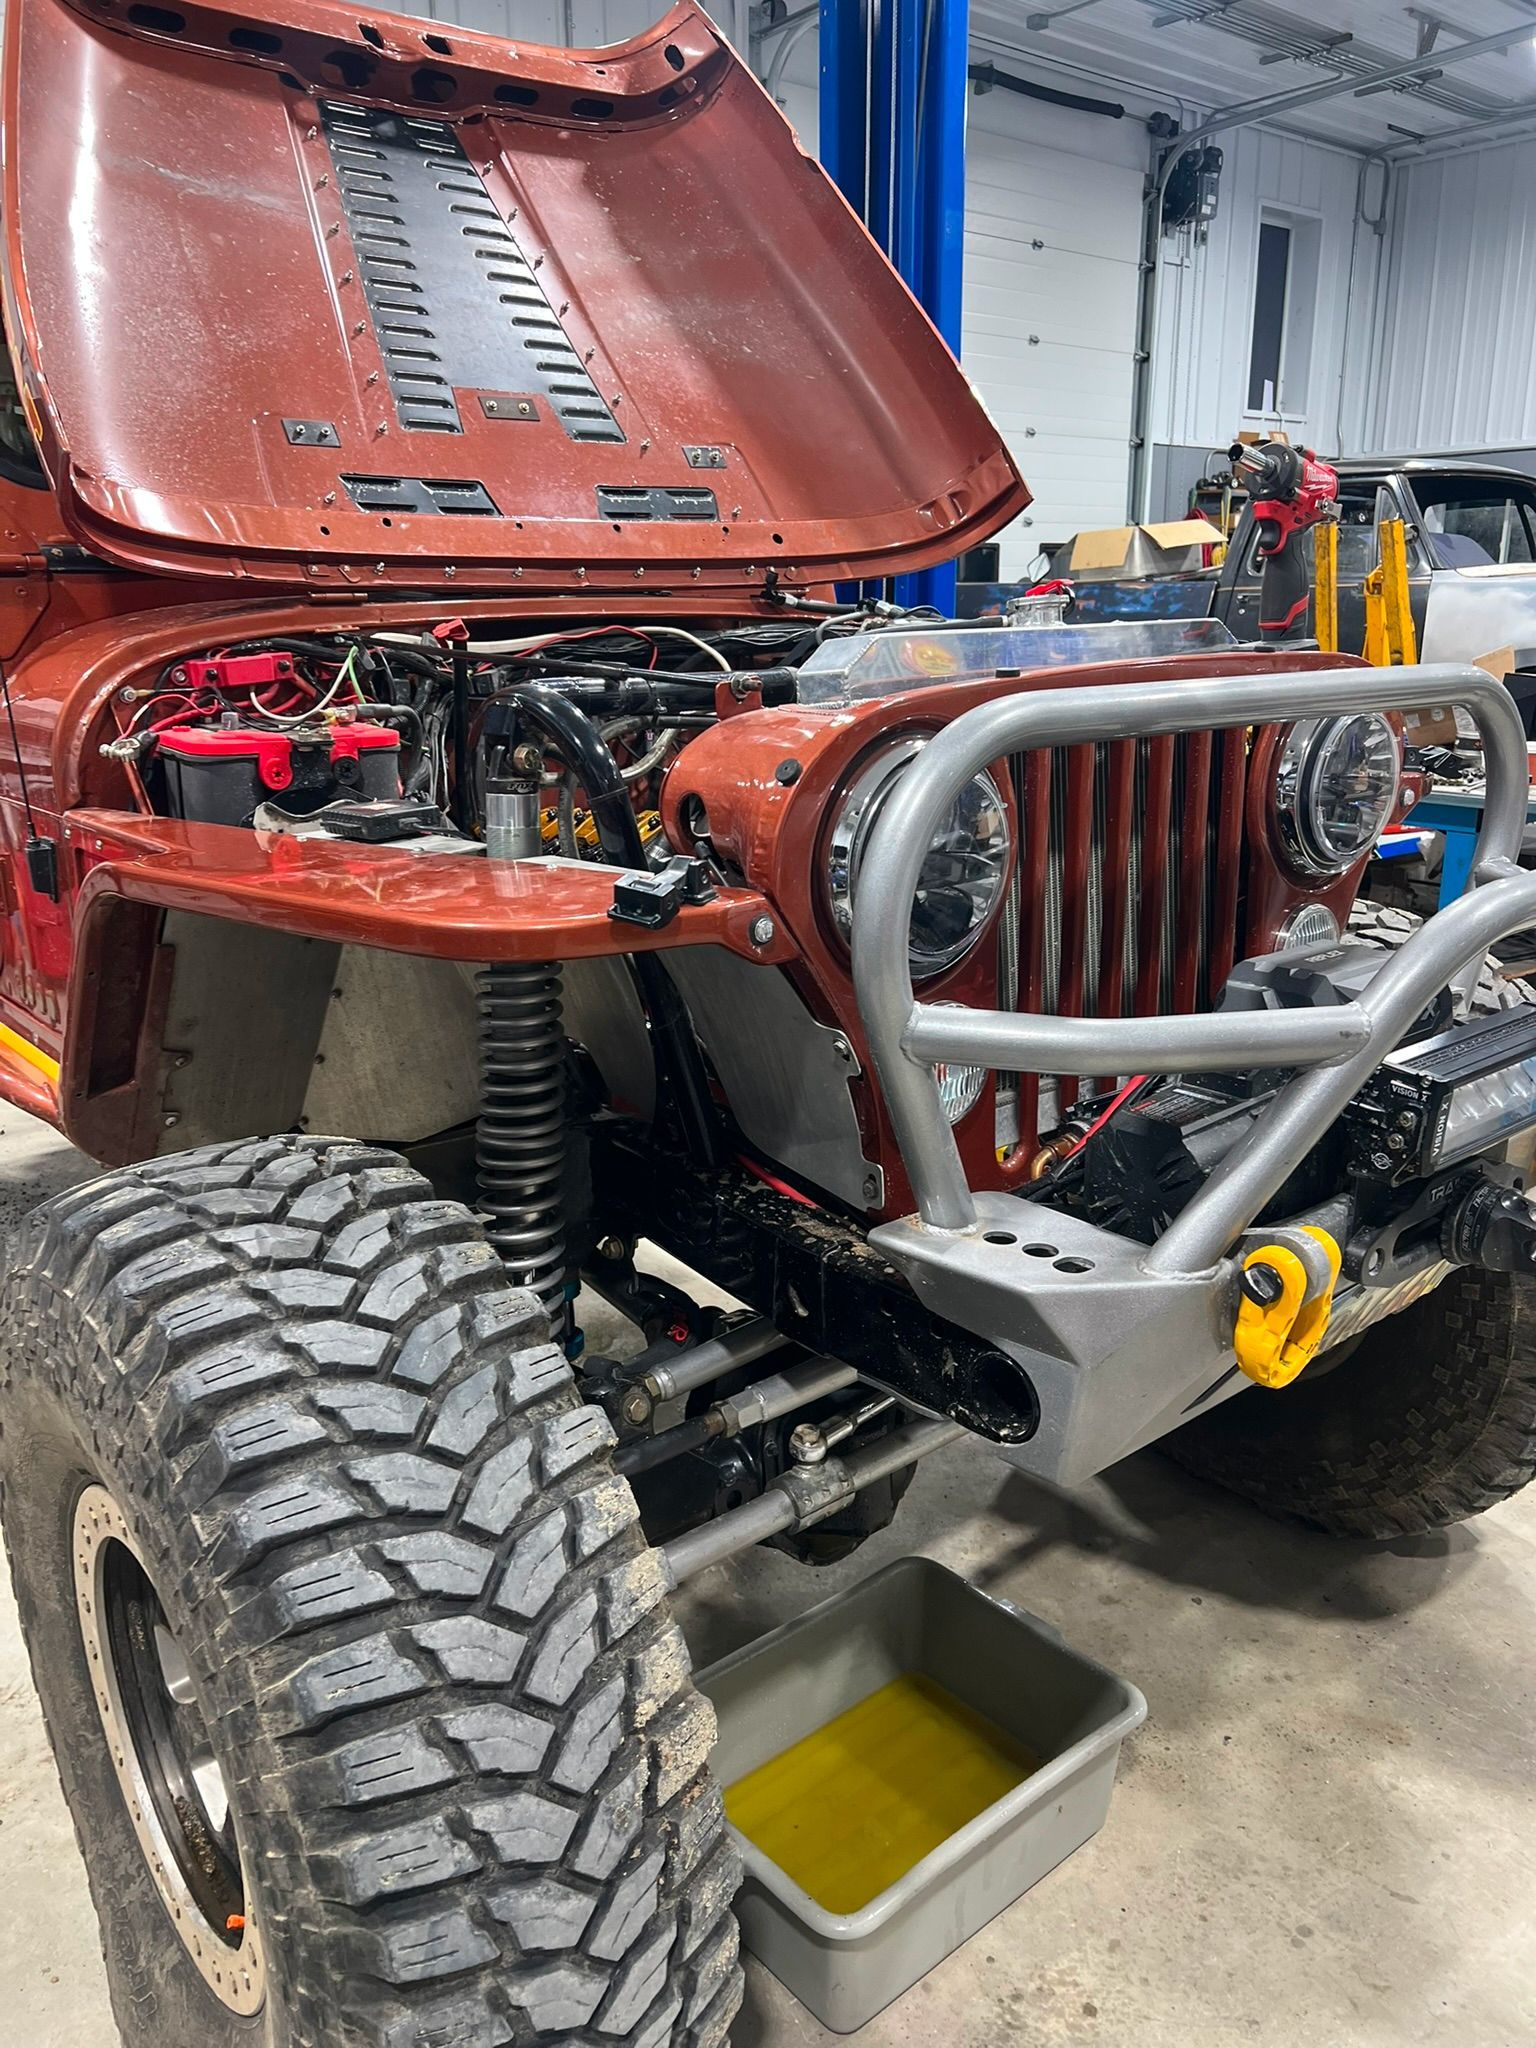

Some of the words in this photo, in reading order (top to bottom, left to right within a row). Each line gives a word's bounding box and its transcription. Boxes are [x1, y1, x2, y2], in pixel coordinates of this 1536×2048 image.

[1391, 1084, 1419, 1100] VISION
[1421, 1094, 1429, 1103] X
[1432, 1114, 1447, 1157] VISION
[1441, 1101, 1450, 1112] X
